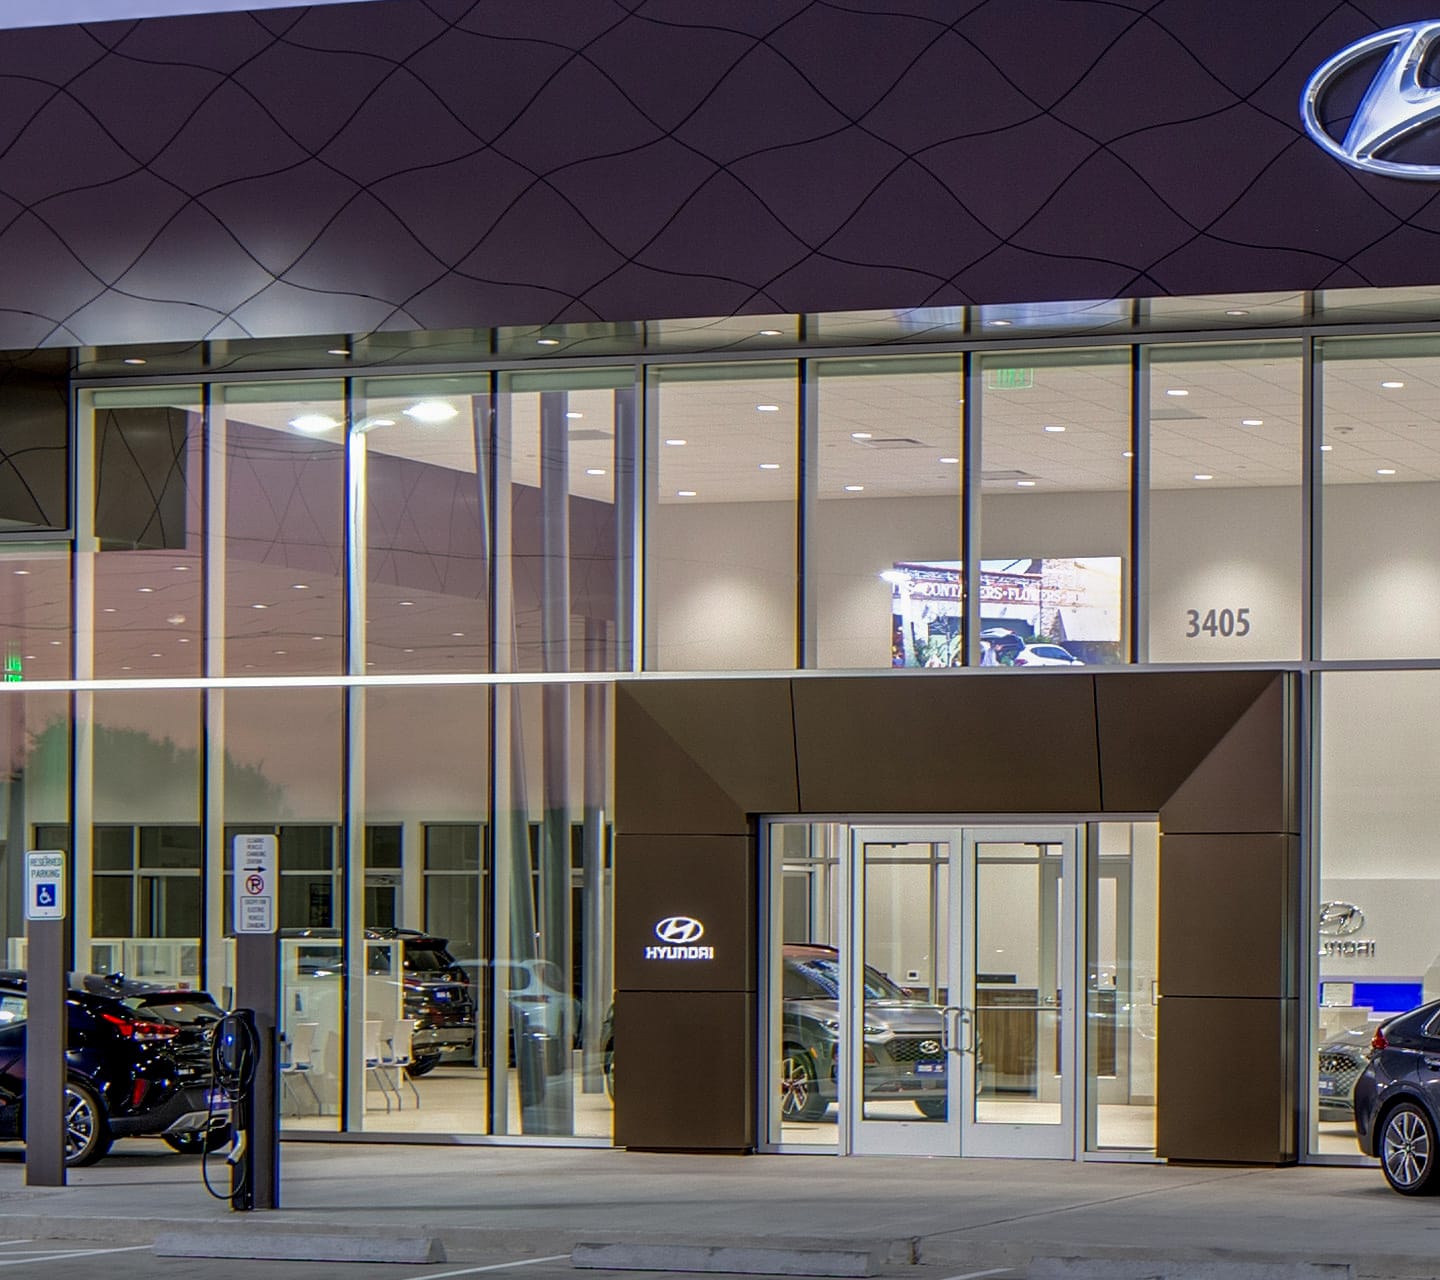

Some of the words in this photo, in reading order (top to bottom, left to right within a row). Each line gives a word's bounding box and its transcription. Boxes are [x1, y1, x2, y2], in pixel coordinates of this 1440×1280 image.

[1185, 607, 1250, 638] 3405
[31, 870, 60, 878] PARKING
[645, 946, 714, 960] HYUNDAI
